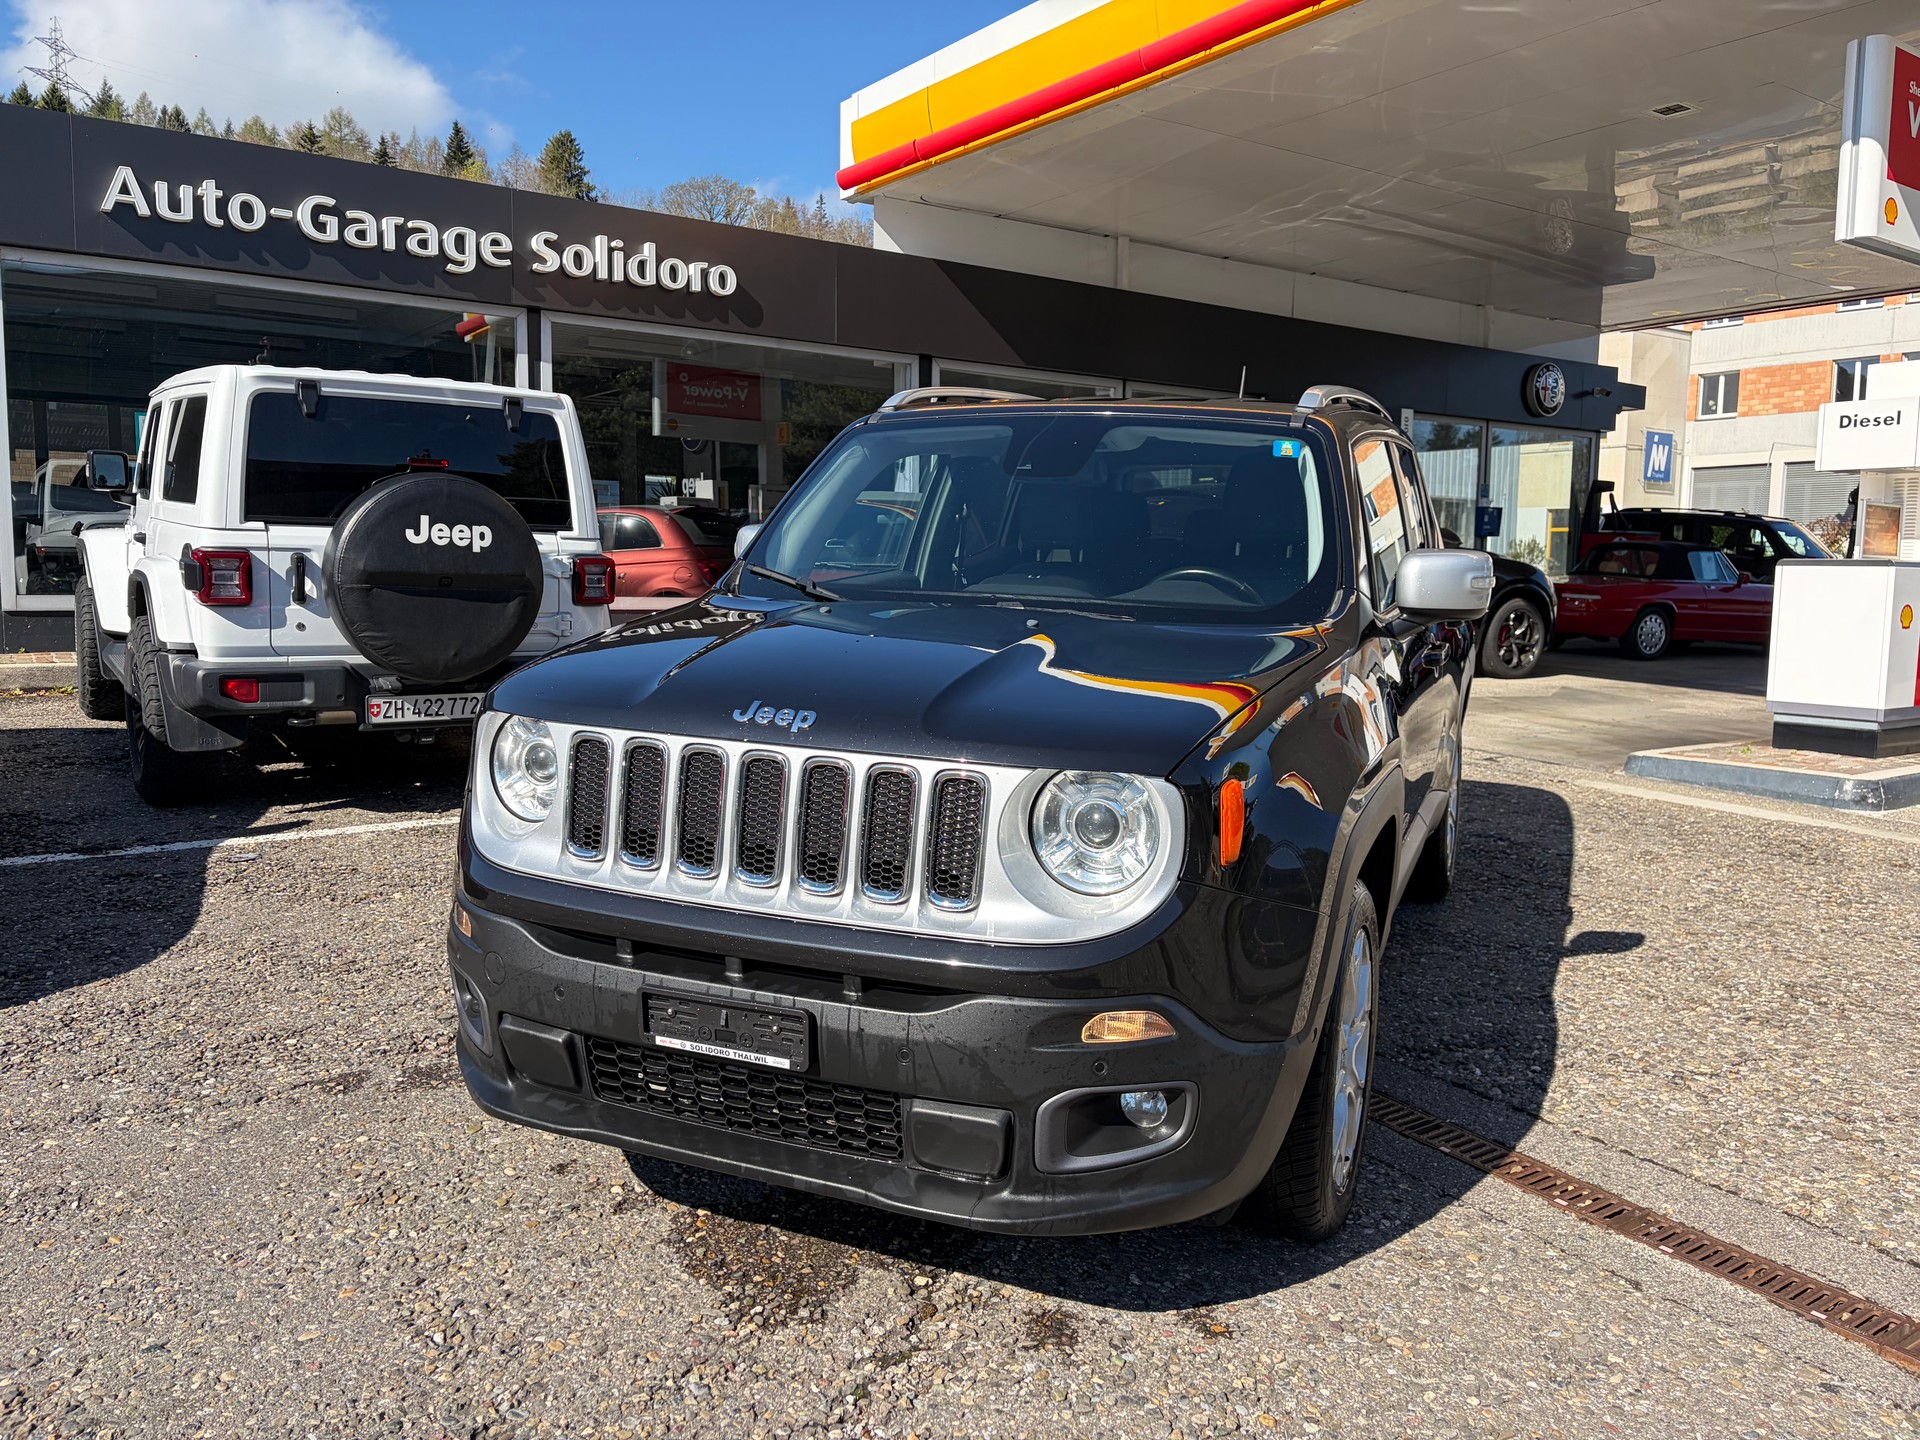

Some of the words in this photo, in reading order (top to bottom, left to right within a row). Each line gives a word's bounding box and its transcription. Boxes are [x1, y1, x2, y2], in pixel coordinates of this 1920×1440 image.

[100, 165, 513, 275] Auto-Garage
[530, 230, 738, 297] Solidoro
[1839, 410, 1901, 429] Diesel
[405, 514, 493, 553] Jeep
[732, 700, 818, 733] Jeep
[689, 1043, 731, 1057] SOLIDORO
[732, 1051, 769, 1065] THALWIL
